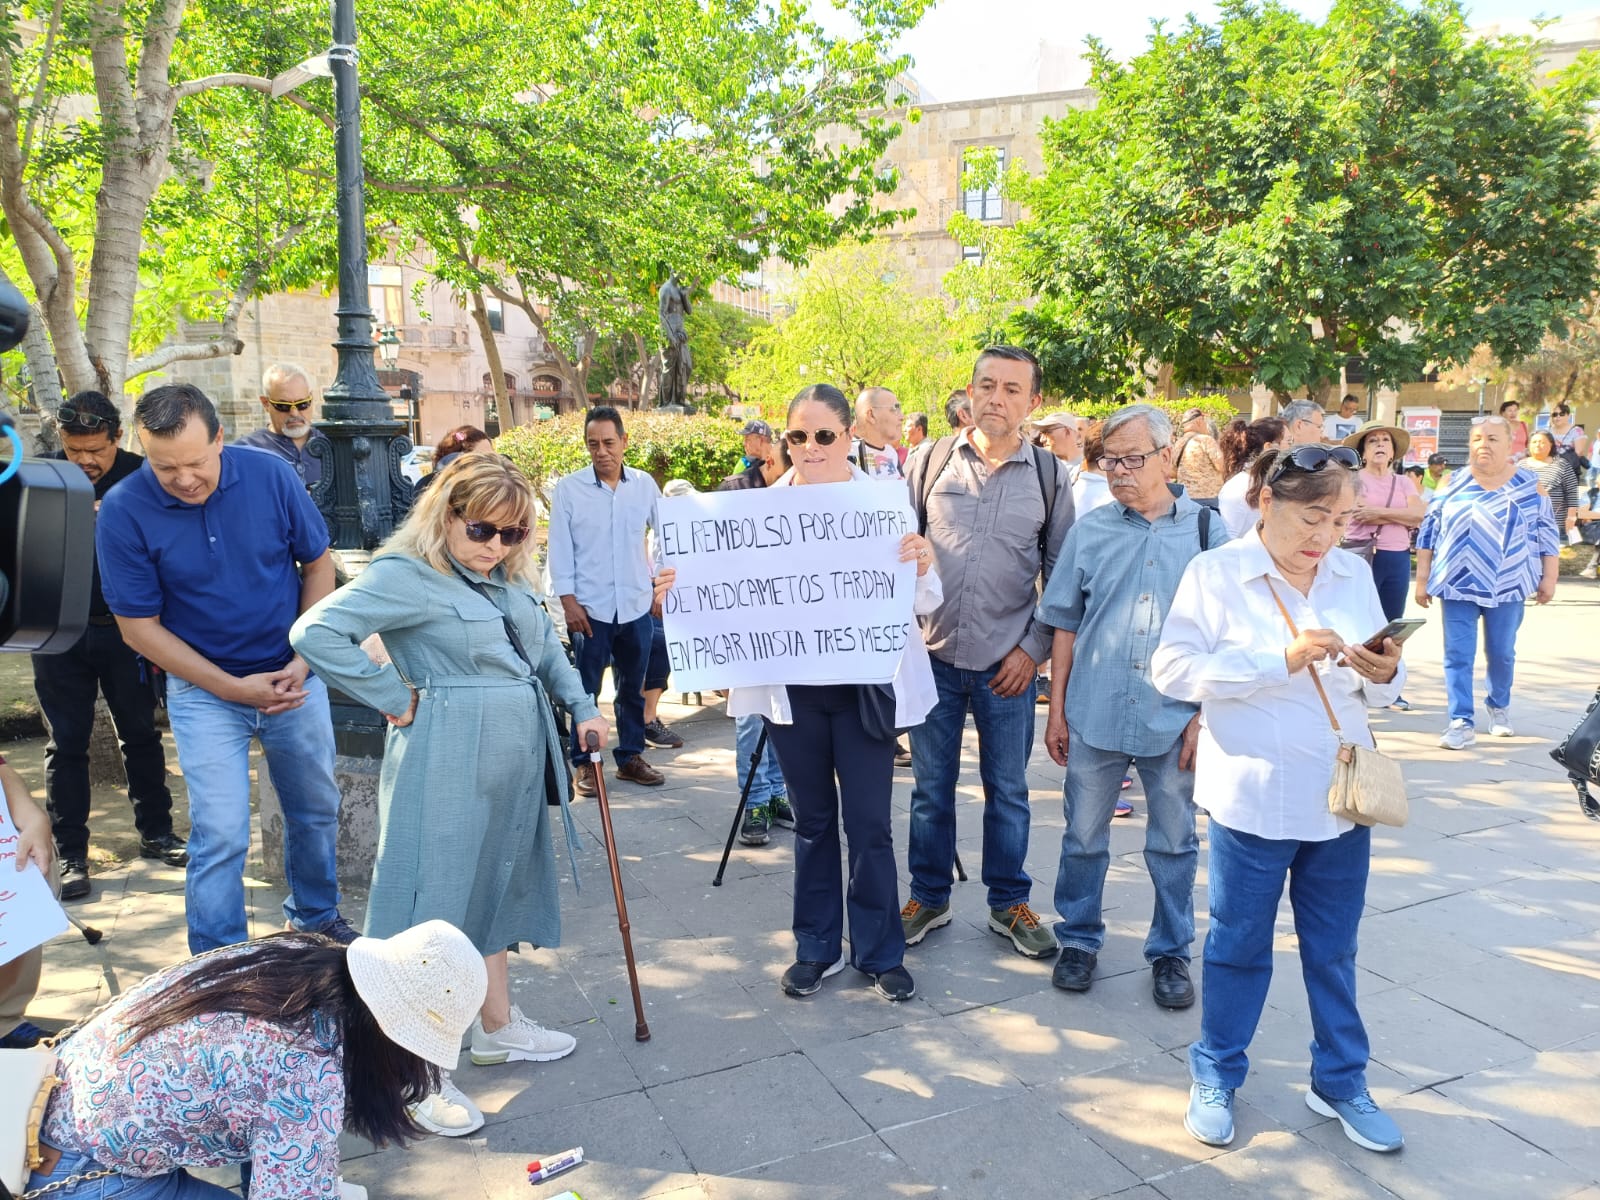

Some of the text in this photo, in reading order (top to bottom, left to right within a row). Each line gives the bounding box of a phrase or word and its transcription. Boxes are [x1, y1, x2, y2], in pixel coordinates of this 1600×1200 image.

[1415, 419, 1431, 430] 5G
[662, 510, 907, 556] EL REMBOLSO POR COMPRA
[665, 570, 895, 614] DE MEDICAMETOS TARDAN
[669, 622, 910, 672] EN PAGAR HASTA TRES MESES
